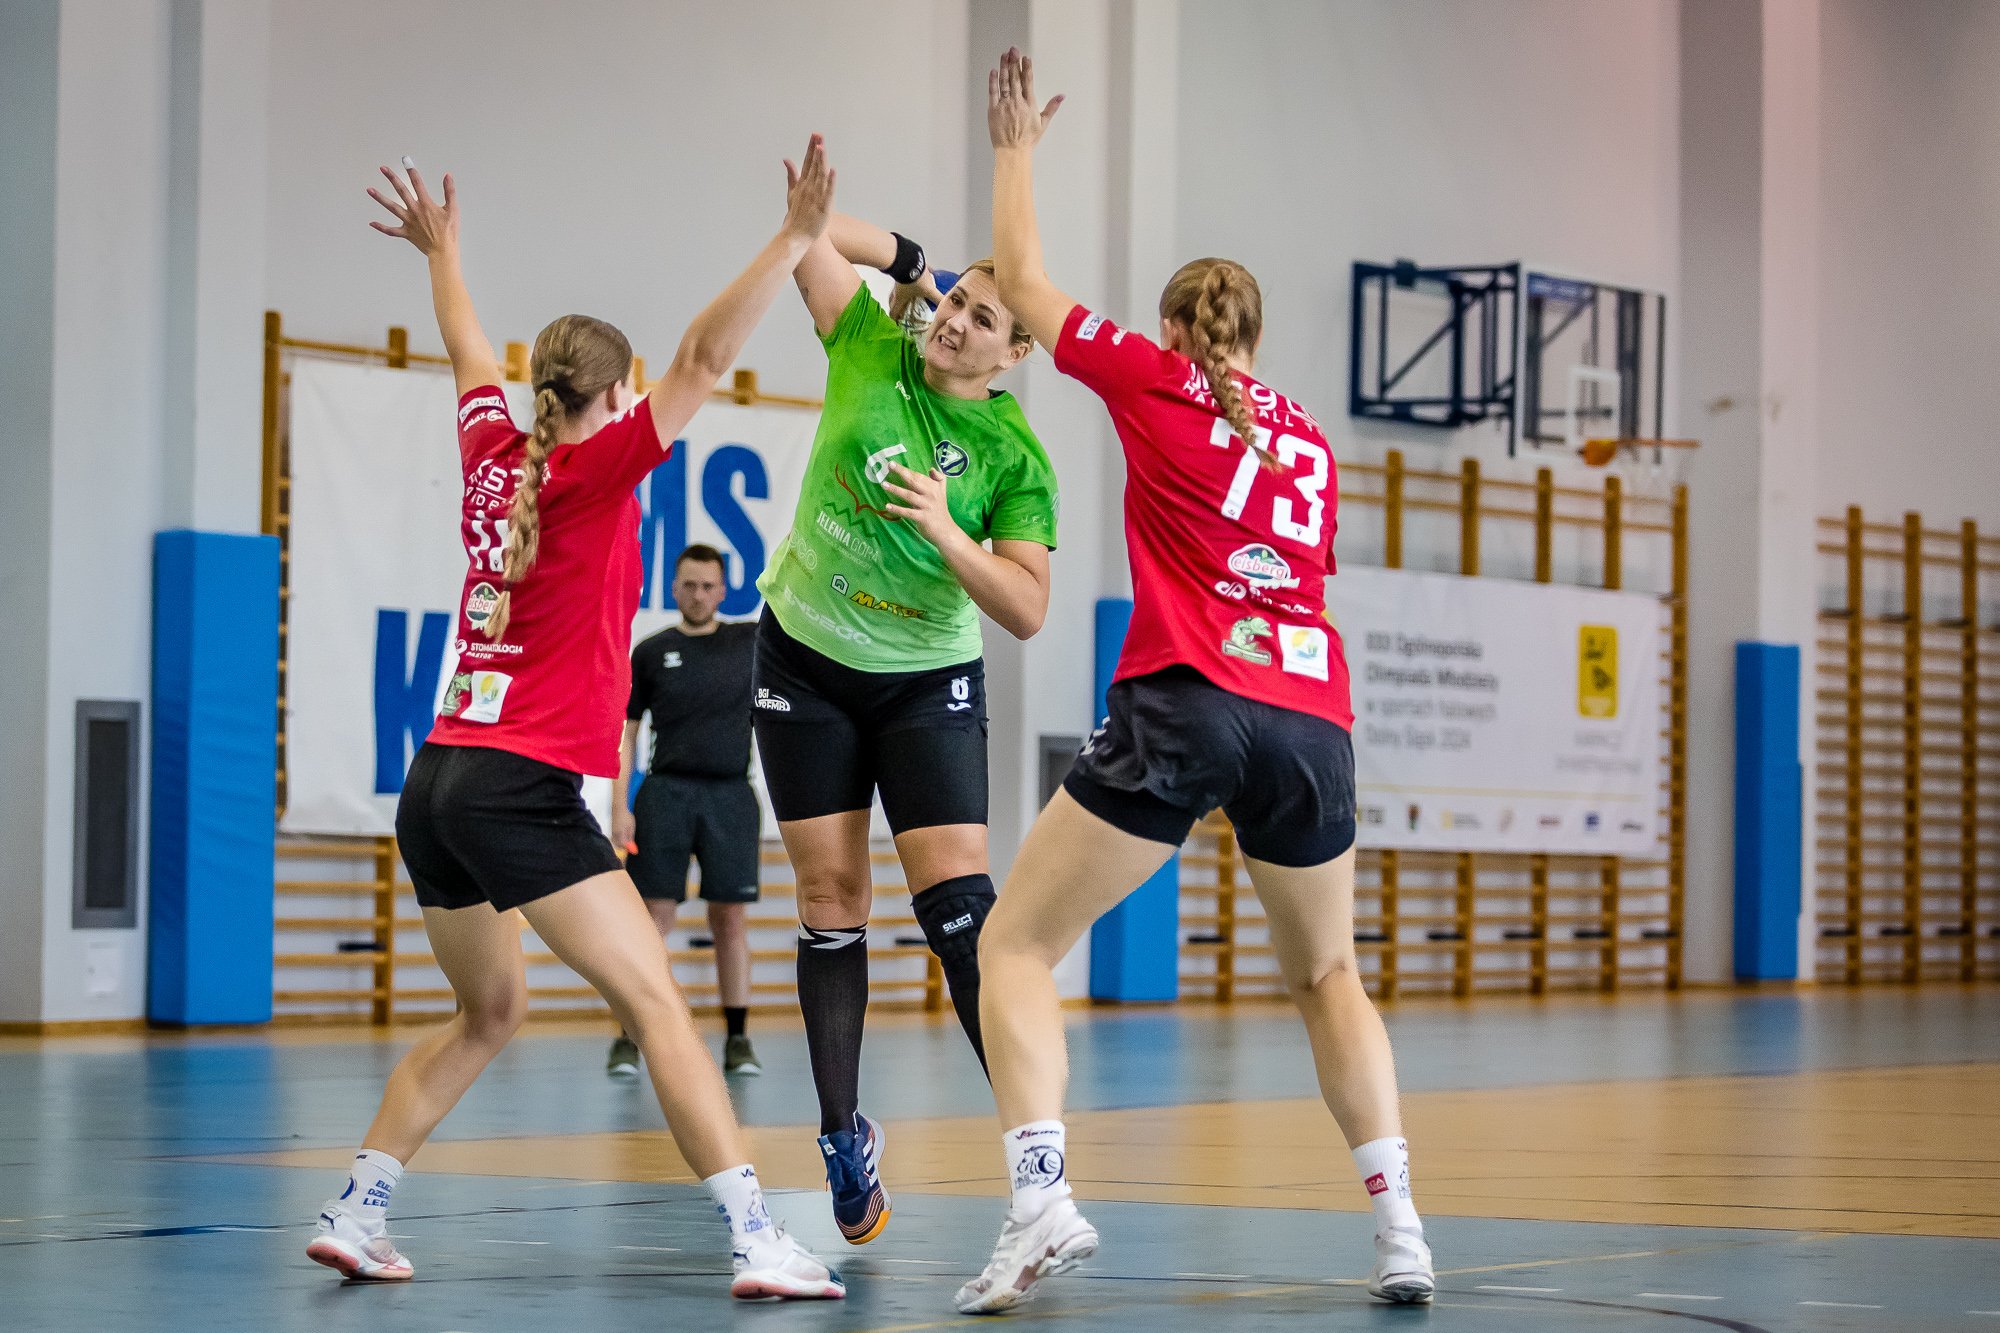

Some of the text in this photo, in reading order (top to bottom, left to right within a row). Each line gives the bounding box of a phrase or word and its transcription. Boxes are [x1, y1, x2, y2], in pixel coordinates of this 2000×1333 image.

[1210, 416, 1328, 548] 73
[817, 511, 852, 548] JELENIA
[1232, 553, 1288, 580] eisberg
[758, 687, 769, 698] BGI
[942, 913, 973, 933] SELECT
